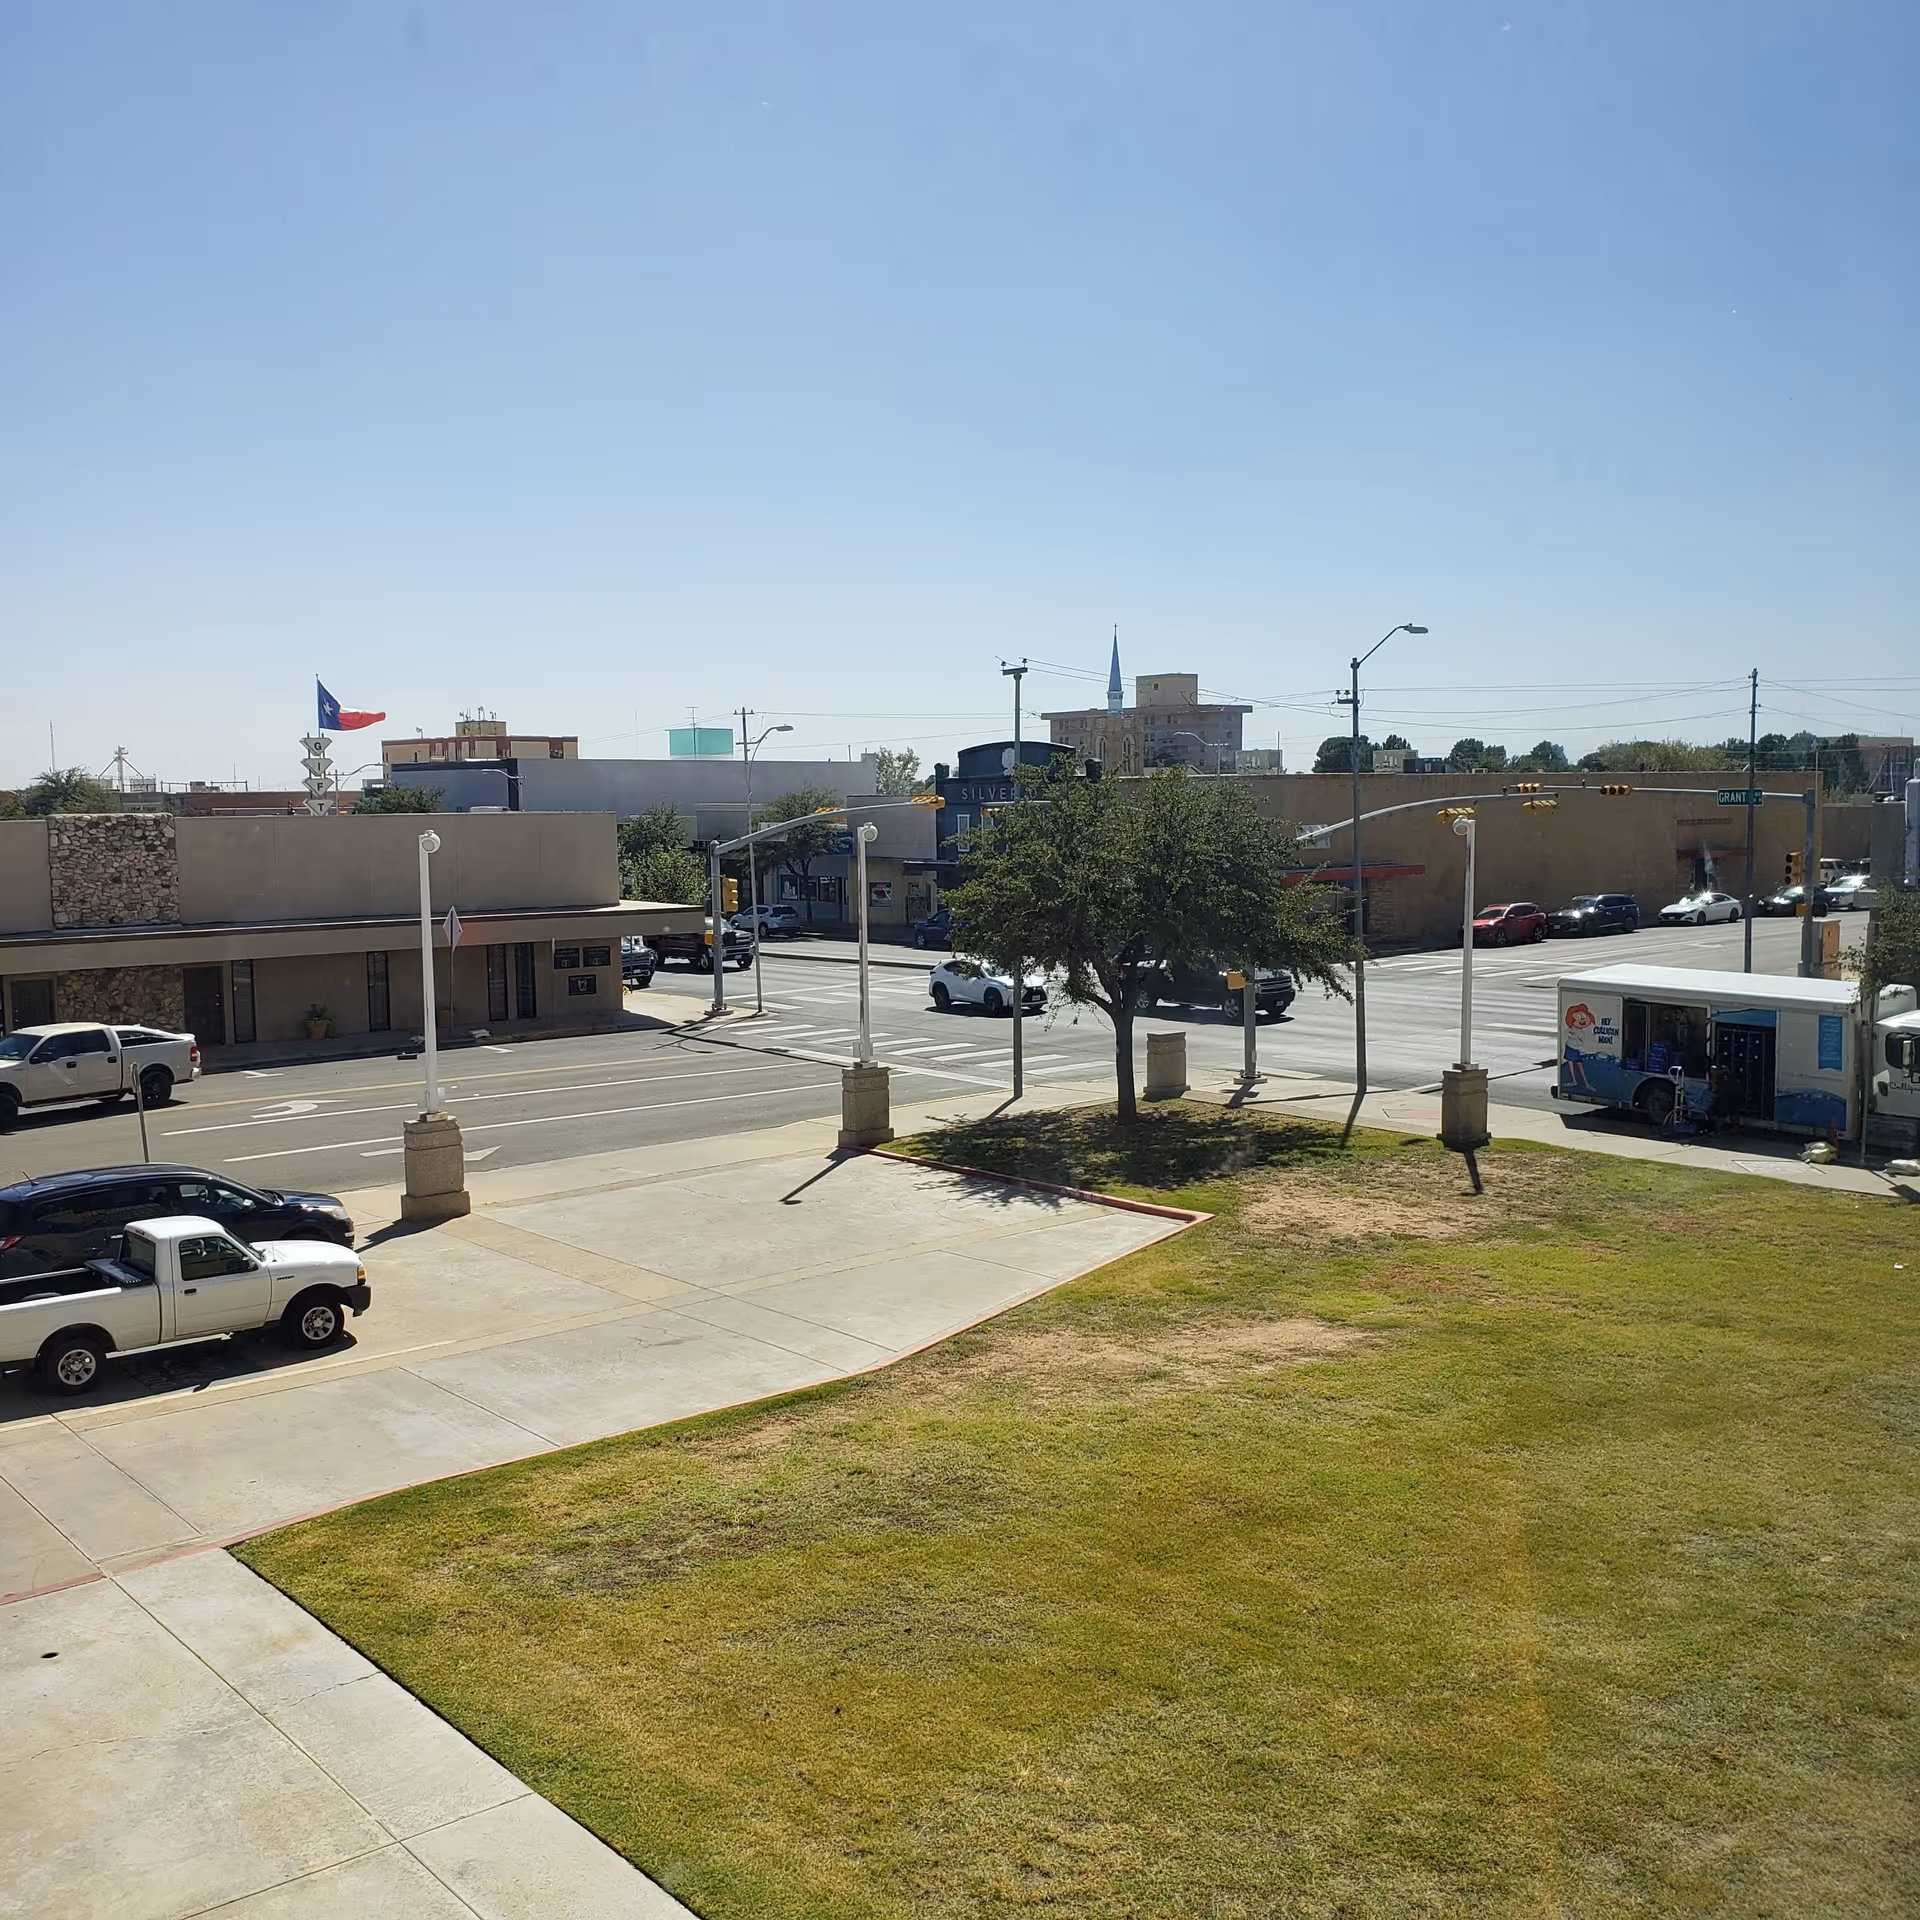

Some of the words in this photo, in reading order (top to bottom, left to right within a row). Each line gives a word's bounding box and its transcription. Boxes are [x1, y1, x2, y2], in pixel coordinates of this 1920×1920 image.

[313, 741, 325, 812] GIFT
[1718, 792, 1747, 803] GRANT
[1601, 1017, 1612, 1026] HEY
[1593, 1026, 1620, 1036] CULLIGAN
